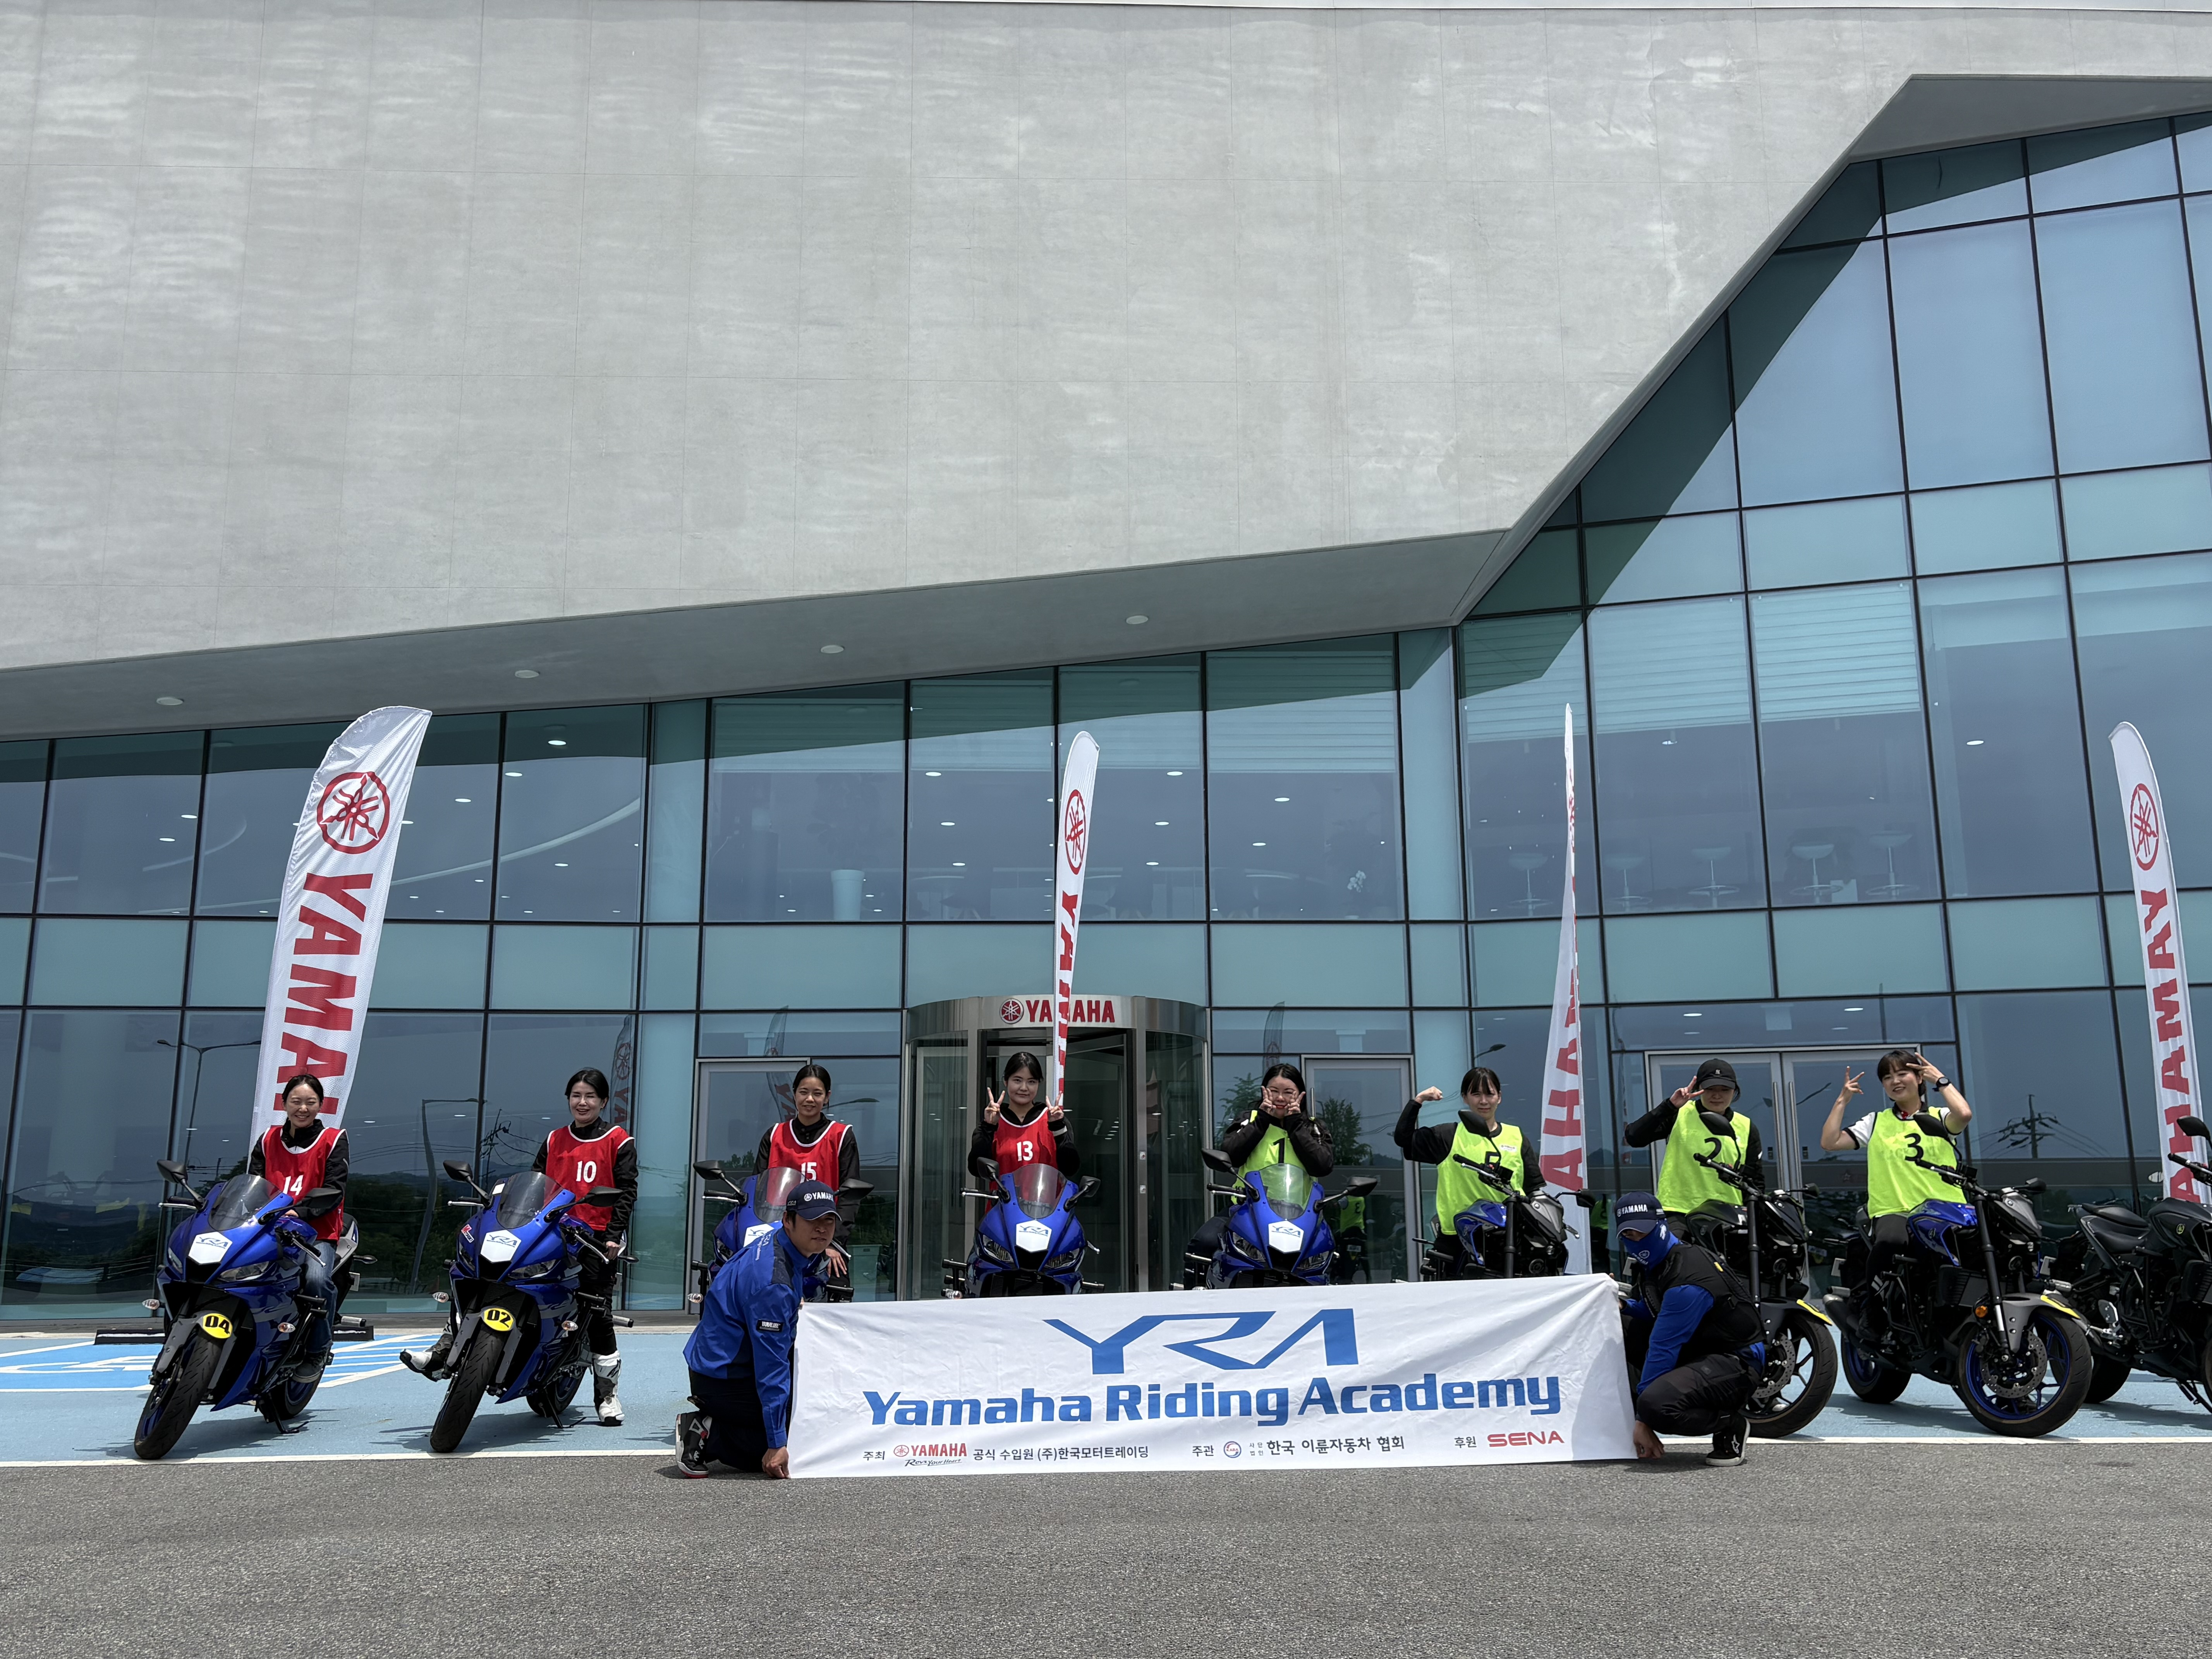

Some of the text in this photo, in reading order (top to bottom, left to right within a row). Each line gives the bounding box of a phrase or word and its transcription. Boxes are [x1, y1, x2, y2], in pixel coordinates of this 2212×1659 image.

[271, 872, 374, 1127] YAMA
[1025, 1000, 1115, 1023] YAAHA
[1017, 1140, 1033, 1161] 13
[1904, 1133, 1924, 1161] 3
[576, 1160, 597, 1183] 10
[800, 1162, 817, 1183] 15
[283, 1175, 304, 1196] 14
[1621, 1204, 1648, 1215] YAMAHA
[205, 1315, 230, 1335] 04
[487, 1309, 511, 1328] 02
[1042, 1309, 1359, 1375] YRA
[862, 1373, 1561, 1427] Yamaha Riding Academy
[1266, 1436, 1405, 1455] 한국 이륜자동차 협회
[1454, 1436, 1477, 1448] 후원
[1487, 1430, 1565, 1448] SENA
[863, 1451, 885, 1461] 주최
[911, 1443, 967, 1456] YAMAHA
[973, 1446, 1149, 1462] 공식 수입원 (주)한국모터트레이딩
[1192, 1445, 1214, 1457] 주관
